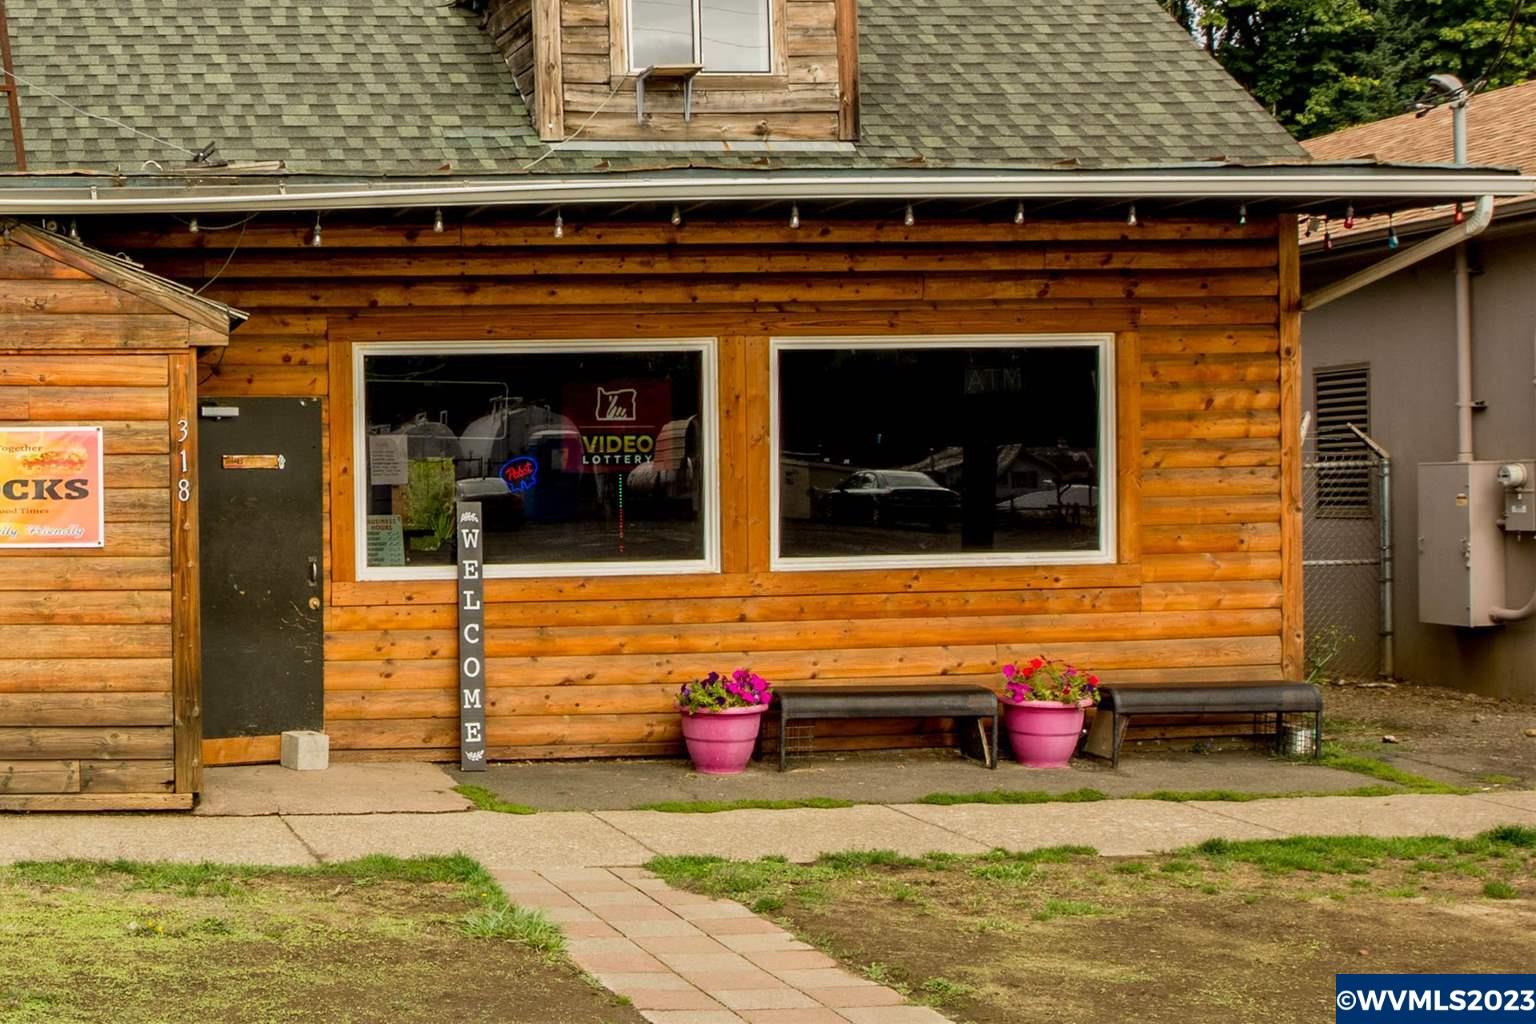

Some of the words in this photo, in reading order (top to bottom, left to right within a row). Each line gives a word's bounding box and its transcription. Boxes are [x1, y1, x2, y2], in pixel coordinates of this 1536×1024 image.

[177, 419, 190, 503] 318
[582, 434, 654, 454] VIDEO
[582, 455, 652, 465] LOTTERY
[461, 529, 482, 743] WELCOME
